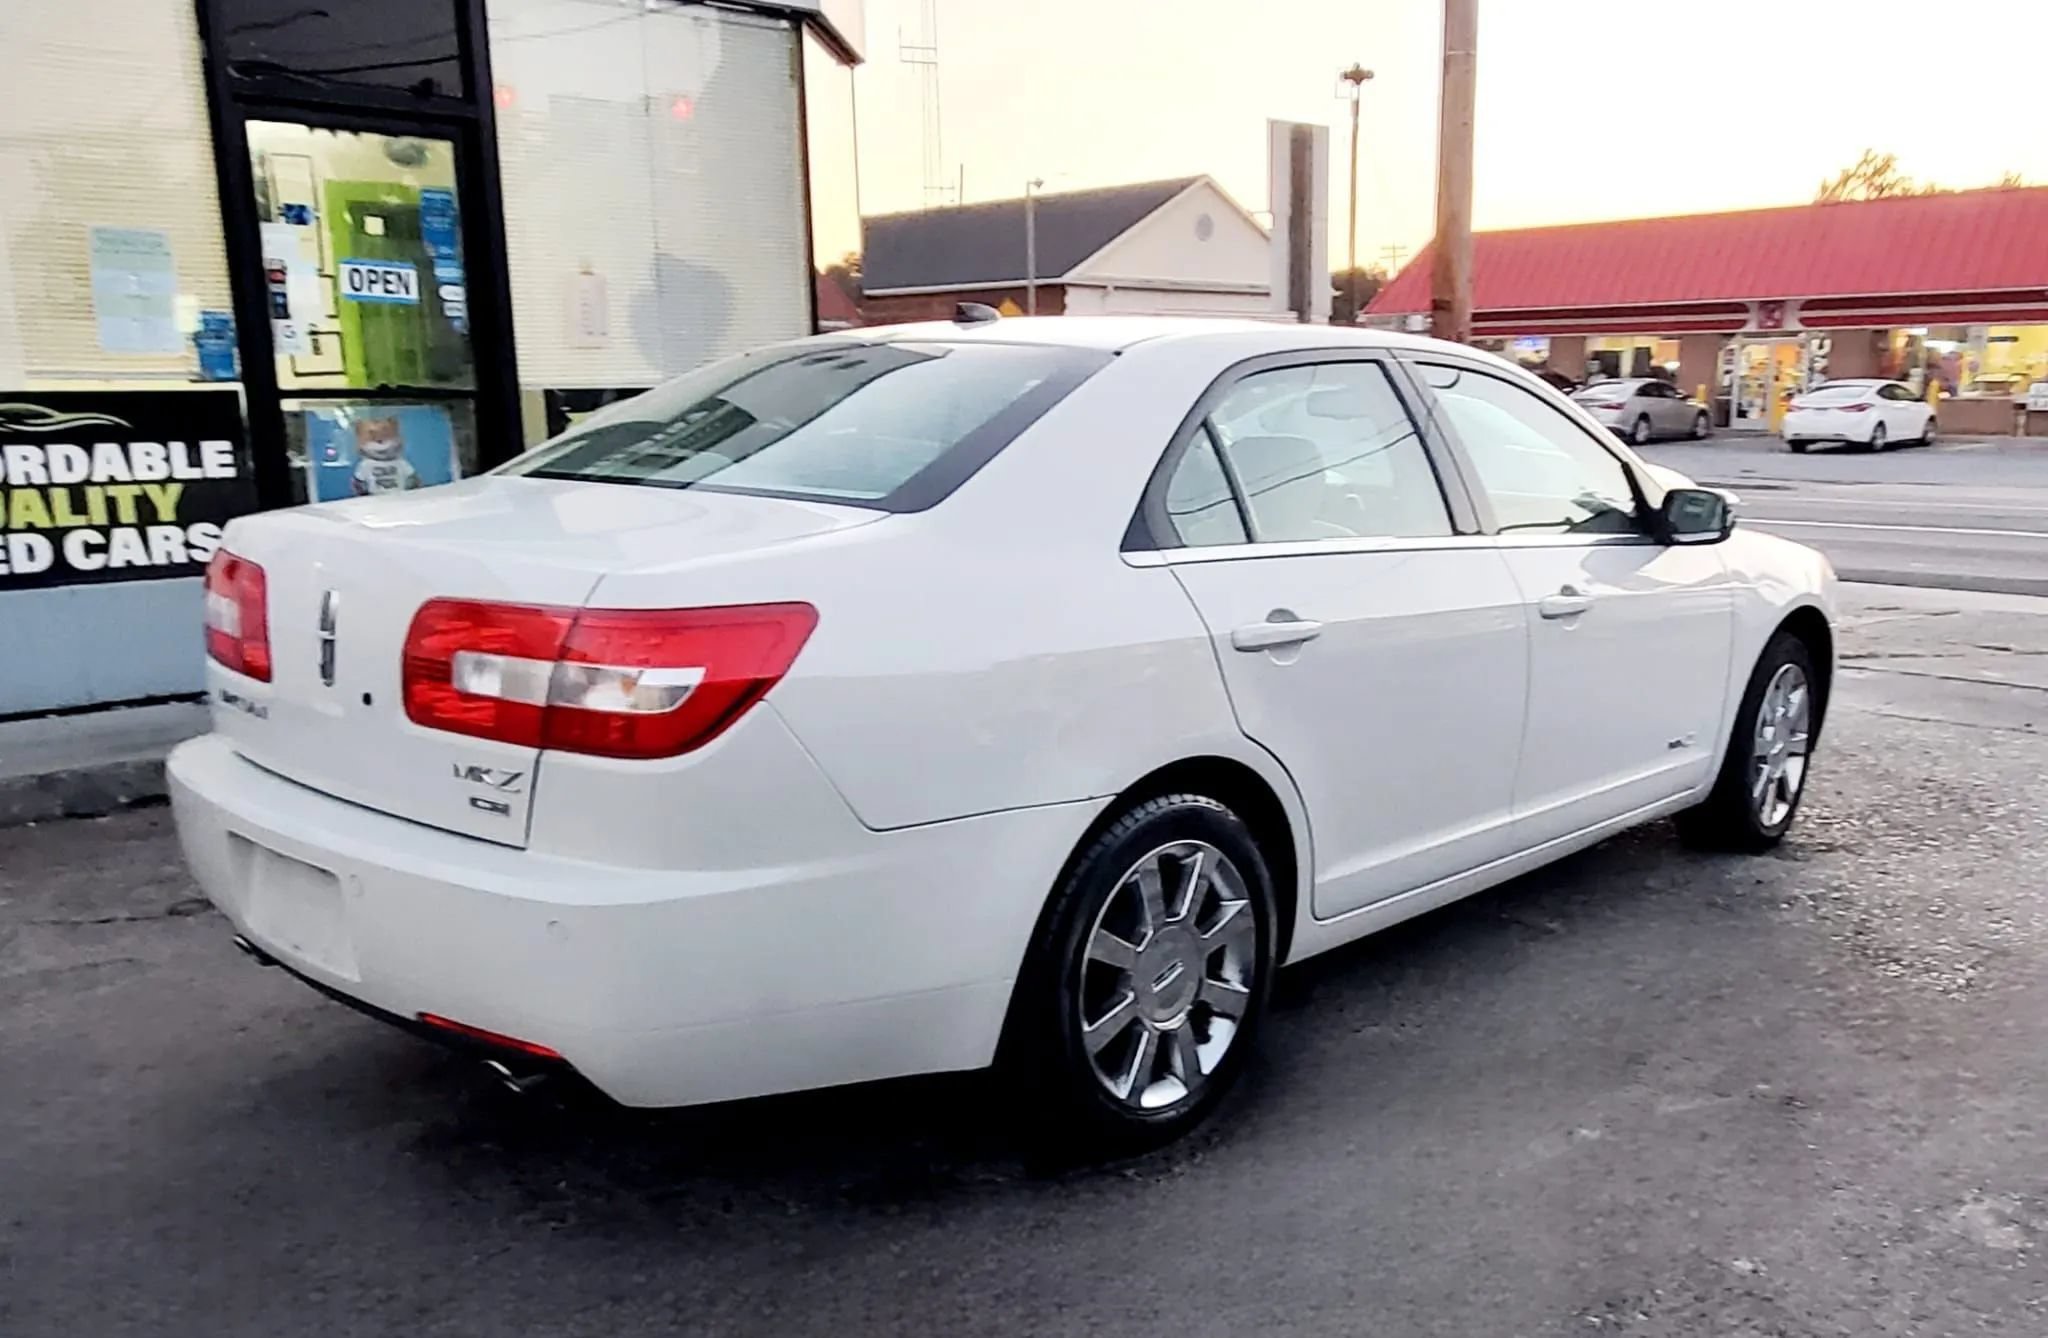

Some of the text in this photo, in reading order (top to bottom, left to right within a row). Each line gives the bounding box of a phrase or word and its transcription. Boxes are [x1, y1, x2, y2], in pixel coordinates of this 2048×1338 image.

[349, 267, 411, 296] OPEN
[0, 440, 237, 485] RDABLE
[0, 483, 183, 529] ALITY
[0, 522, 223, 575] D CARS
